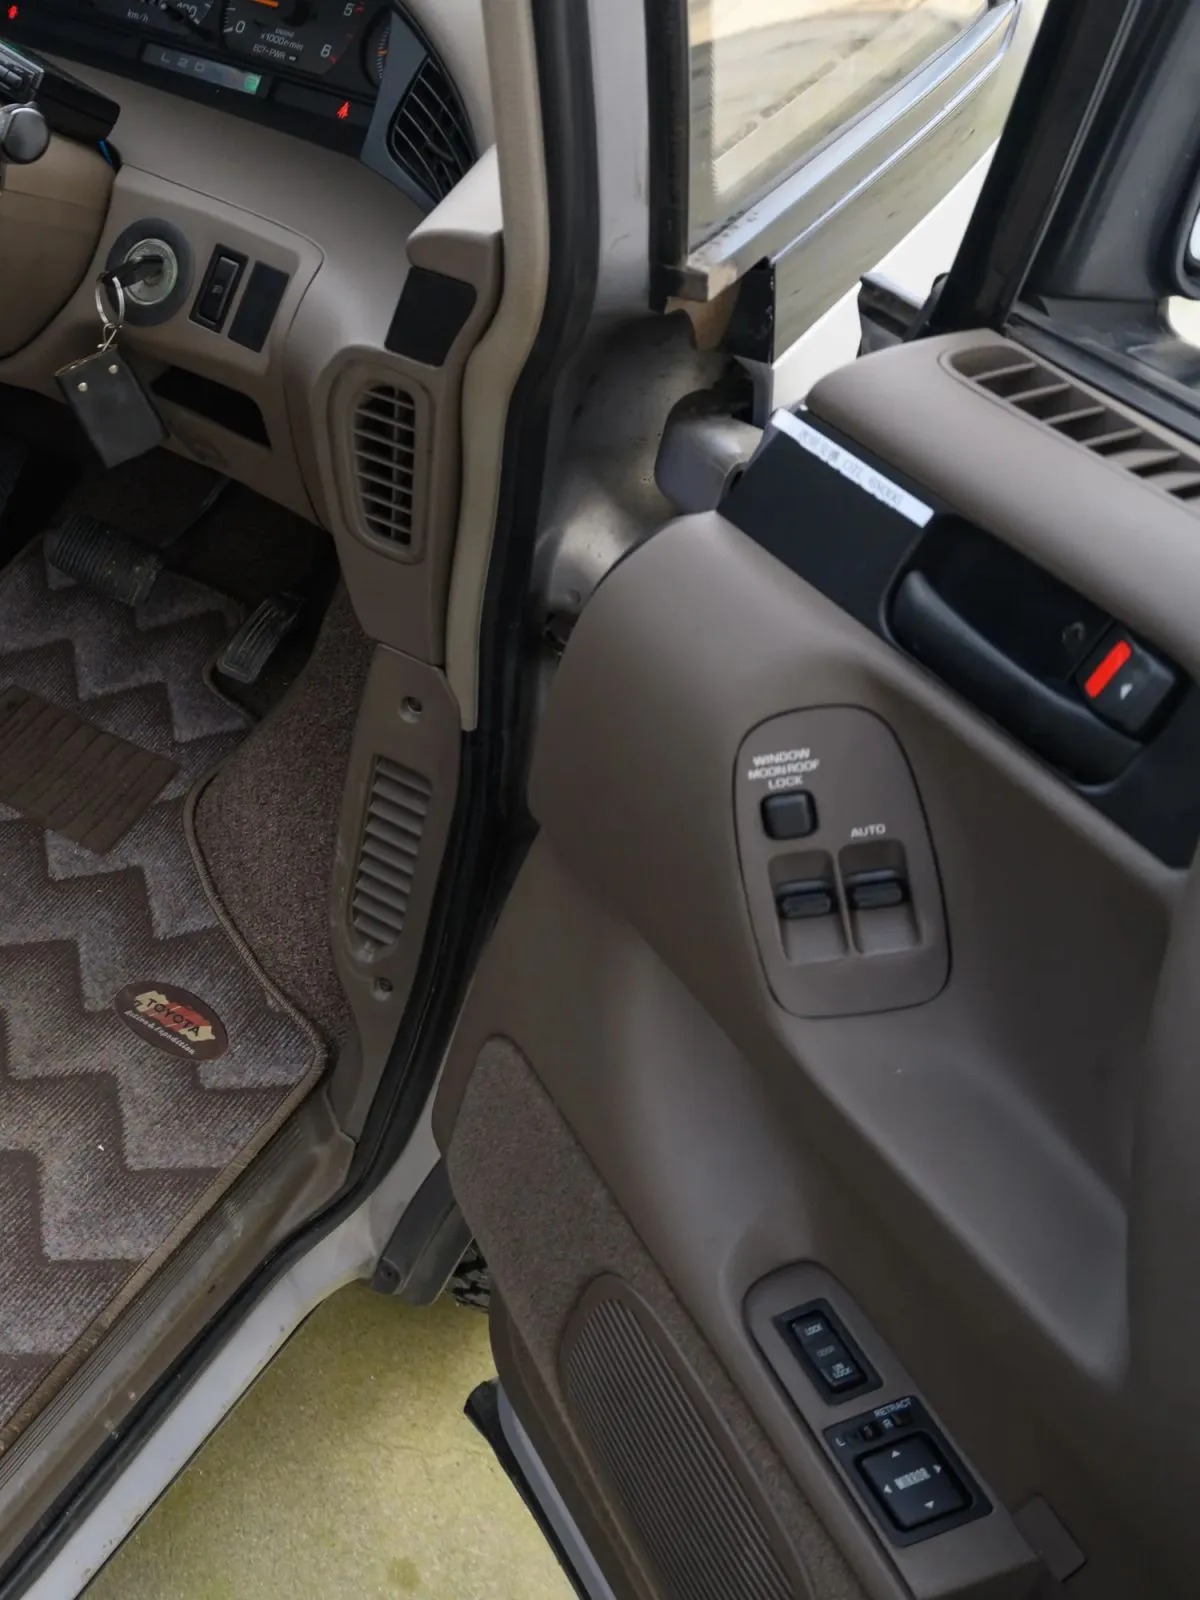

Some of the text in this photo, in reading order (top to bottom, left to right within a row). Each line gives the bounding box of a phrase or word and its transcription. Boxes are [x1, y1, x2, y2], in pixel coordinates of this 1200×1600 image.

[127, 8, 149, 23] km/h
[235, 20, 246, 33] 0
[752, 748, 810, 767] WINDOW
[767, 775, 804, 790] LOCK
[850, 824, 886, 838] AUTO
[146, 998, 200, 1037] TOYOTA
[874, 1397, 912, 1419] RETRACT
[835, 1417, 894, 1448] L R
